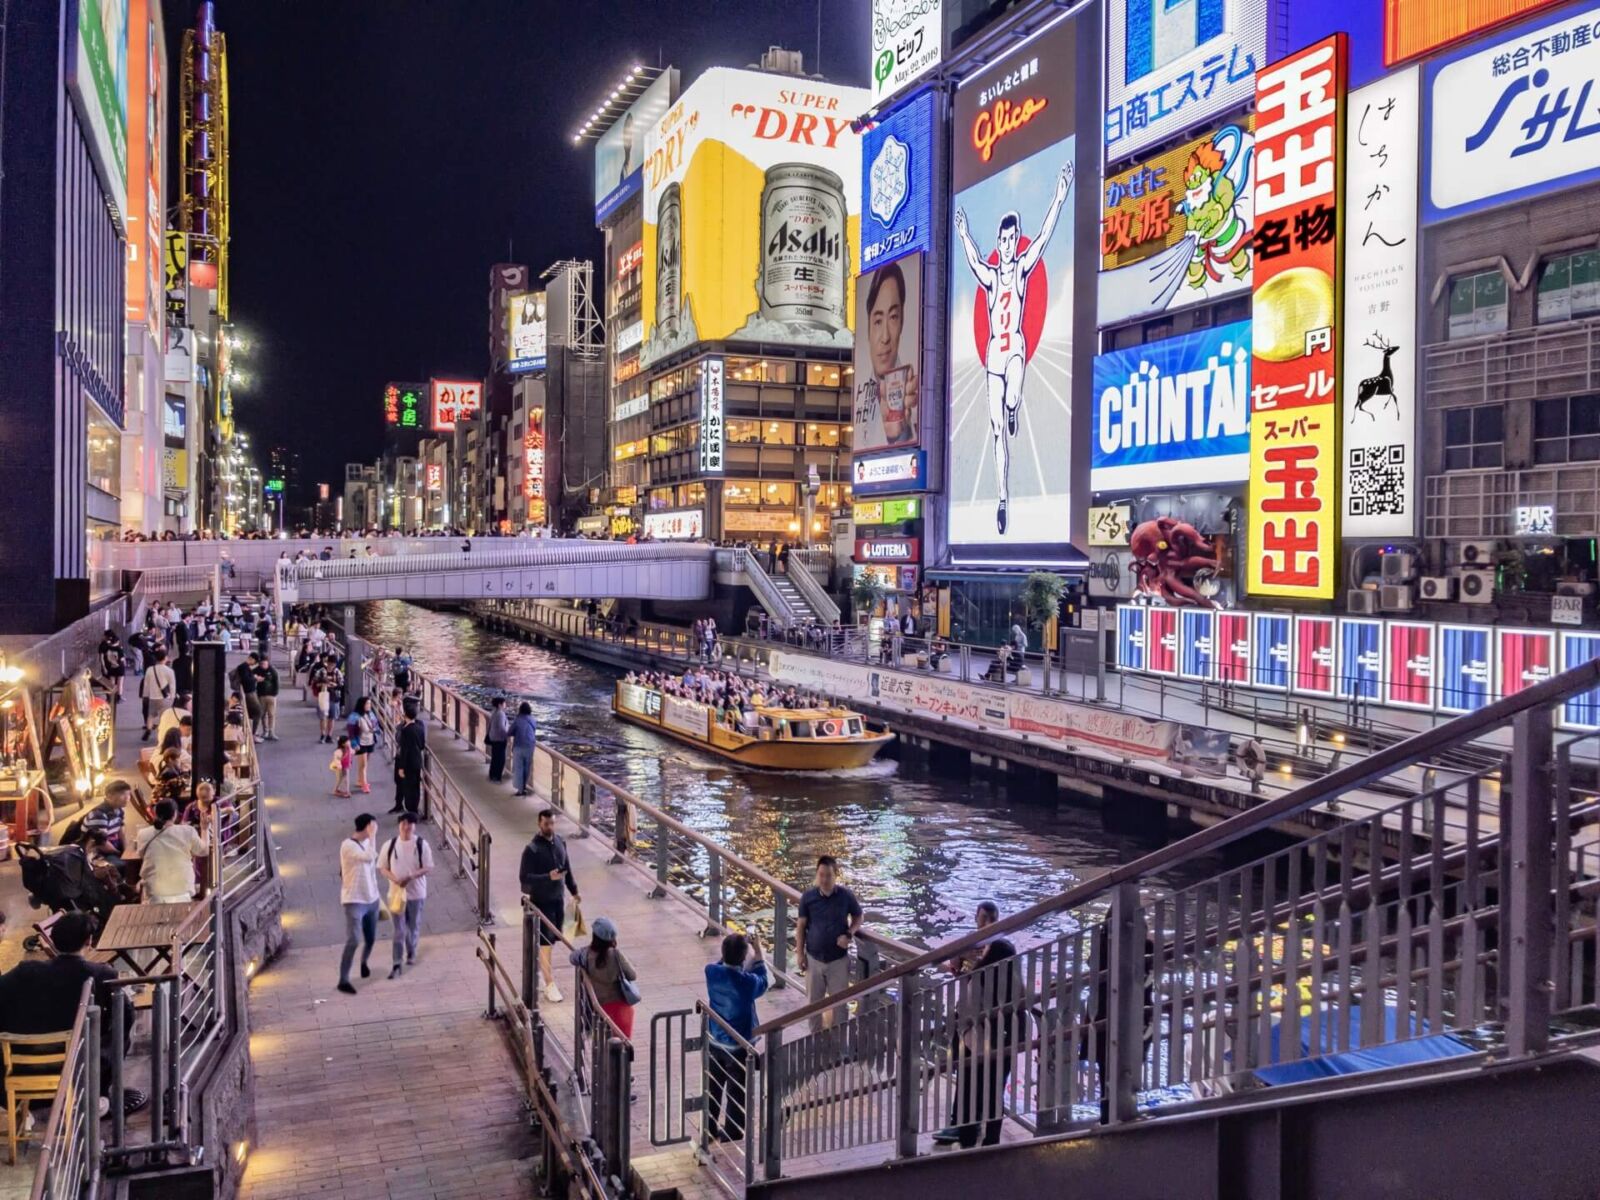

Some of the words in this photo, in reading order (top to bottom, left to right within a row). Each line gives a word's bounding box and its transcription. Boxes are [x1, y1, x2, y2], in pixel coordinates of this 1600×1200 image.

[896, 26, 925, 65] ピップ
[777, 89, 840, 111] SUPER
[1104, 44, 1255, 146] 日商エステム
[973, 98, 1048, 162] Glico
[1254, 46, 1336, 216] 玉出
[1106, 166, 1167, 207] かぜに
[768, 221, 839, 260] Asahi
[1101, 190, 1173, 256] 改源
[1253, 204, 1336, 262] 名物
[794, 267, 815, 282] 生
[1354, 264, 1404, 282] HACHIKAN
[1359, 278, 1399, 293] YOSHINO
[1368, 300, 1391, 315] 吉野
[1305, 326, 1332, 357] 円
[1251, 369, 1335, 410] セール
[1264, 415, 1321, 440] スーパー
[1261, 445, 1322, 588] 玉出
[1517, 507, 1553, 527] BAR
[872, 543, 907, 557] LOTTERIA
[1553, 598, 1581, 611] BAR
